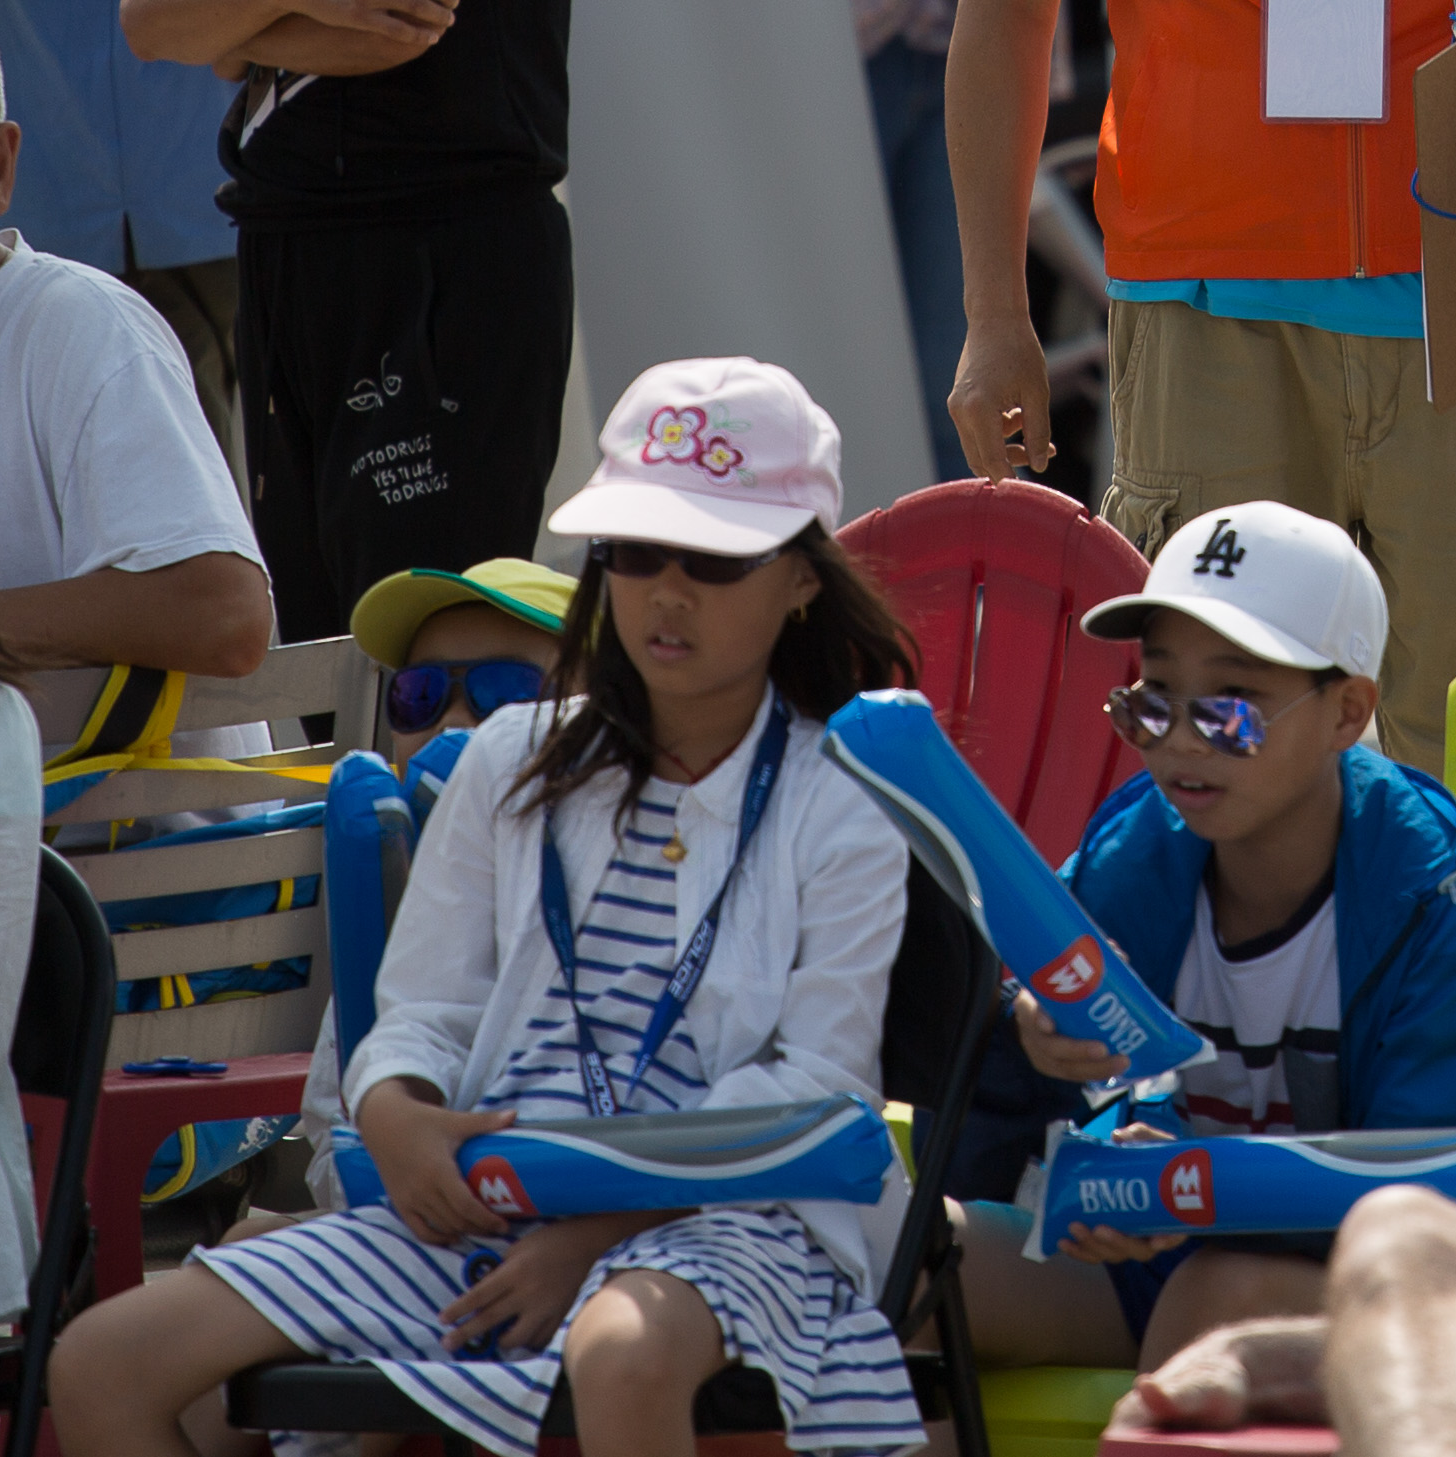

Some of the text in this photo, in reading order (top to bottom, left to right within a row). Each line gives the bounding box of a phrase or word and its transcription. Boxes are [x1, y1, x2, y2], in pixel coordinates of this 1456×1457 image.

[1193, 518, 1246, 577] LA
[668, 919, 709, 1000] POLICE
[1088, 992, 1149, 1055] BMO
[1078, 1178, 1151, 1214] BMO
